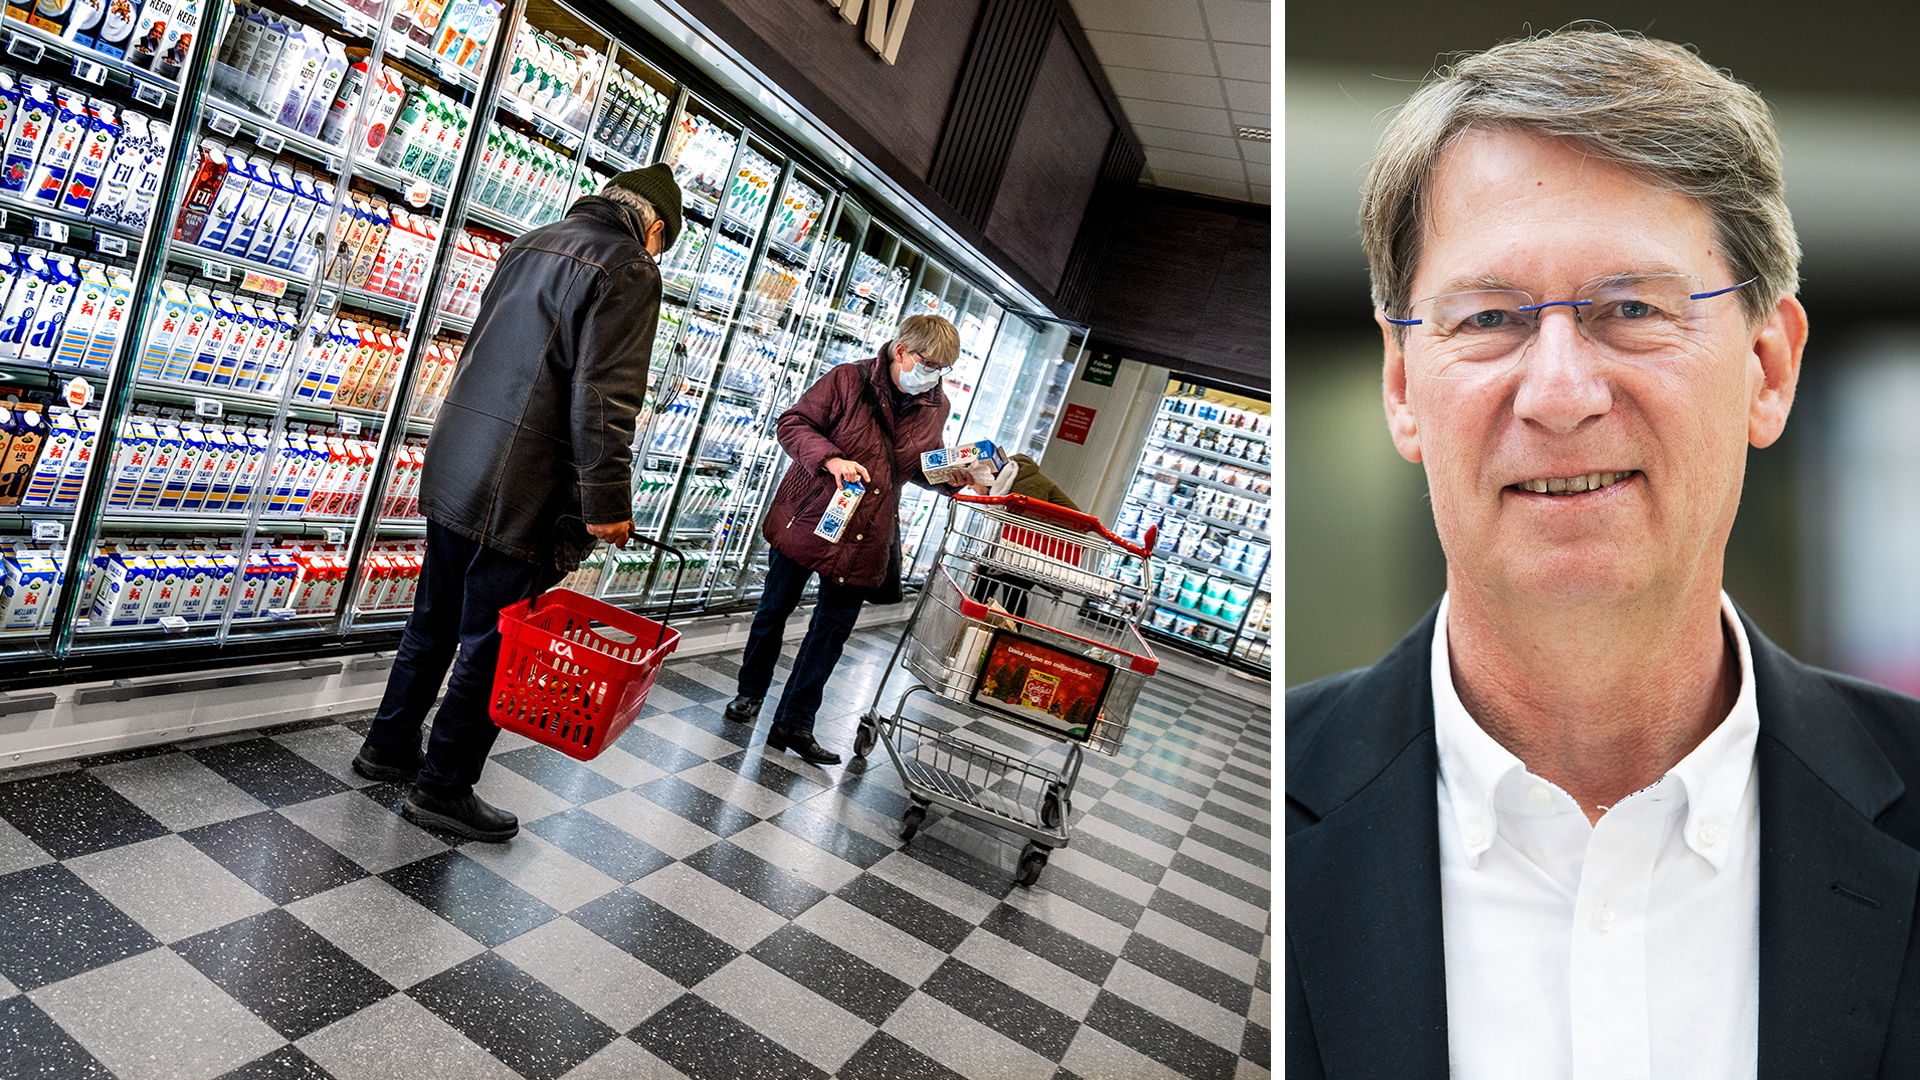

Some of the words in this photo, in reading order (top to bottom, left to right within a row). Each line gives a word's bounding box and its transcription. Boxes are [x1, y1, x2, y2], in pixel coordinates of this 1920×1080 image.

[112, 163, 134, 183] Fil
[193, 189, 211, 206] FIL
[31, 320, 55, 348] a
[13, 443, 36, 453] eko
[549, 639, 574, 660] ICA
[1008, 646, 1024, 656] Unna
[1024, 653, 1043, 664] någon
[1053, 664, 1092, 679] miljonchans!
